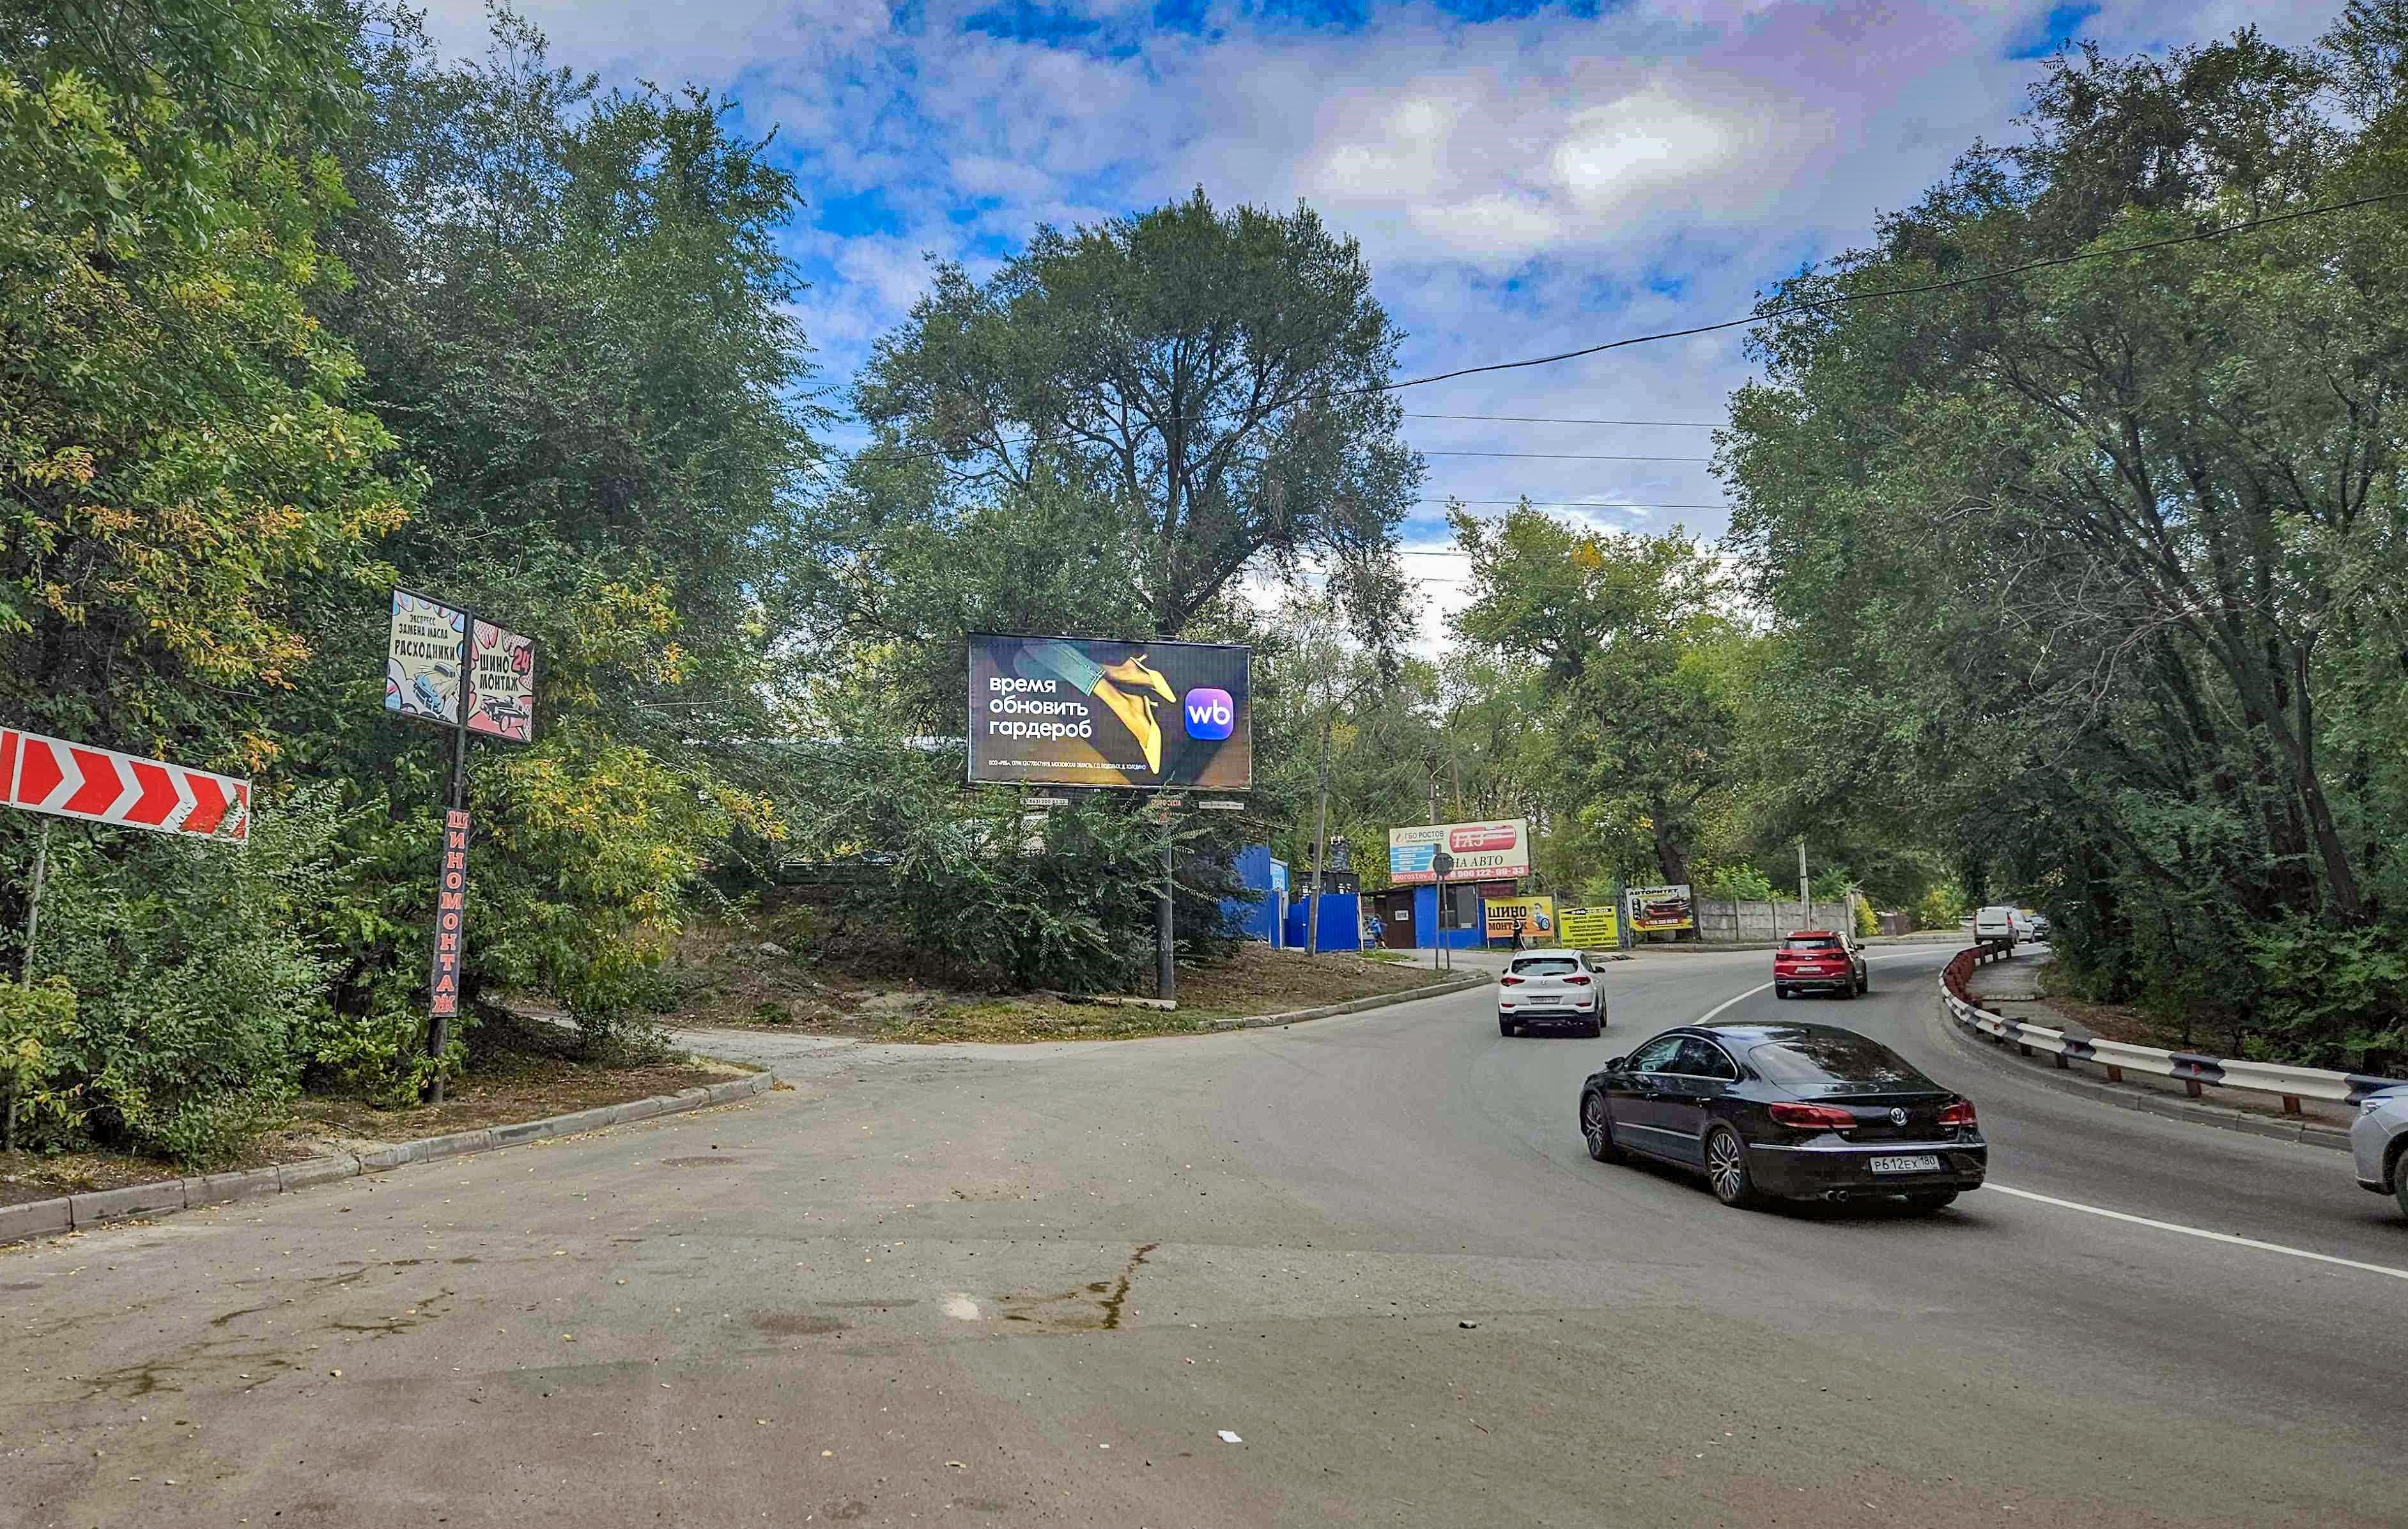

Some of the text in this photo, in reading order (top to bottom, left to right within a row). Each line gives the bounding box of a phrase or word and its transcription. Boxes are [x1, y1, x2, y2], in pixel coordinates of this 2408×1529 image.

[410, 614, 436, 626] ЭКСПРЕСС
[399, 623, 449, 639] ЗАМЕНА МАСЛА
[395, 639, 455, 661] РАСХОДНИКИ
[480, 654, 509, 674] ШИНО
[511, 646, 531, 676] 24
[480, 674, 518, 691] МОНТАЖ
[989, 678, 1056, 696] время
[989, 695, 1089, 717] обновить
[1187, 699, 1231, 726] wb
[989, 719, 1092, 741] гардероб
[1471, 855, 1504, 867] АВТО
[431, 811, 469, 1013] ШИНОМОНТАЖ
[1488, 906, 1527, 918] ШИНО
[1488, 921, 1528, 931] МОНТЖ
[1920, 1156, 1936, 1166] 180
